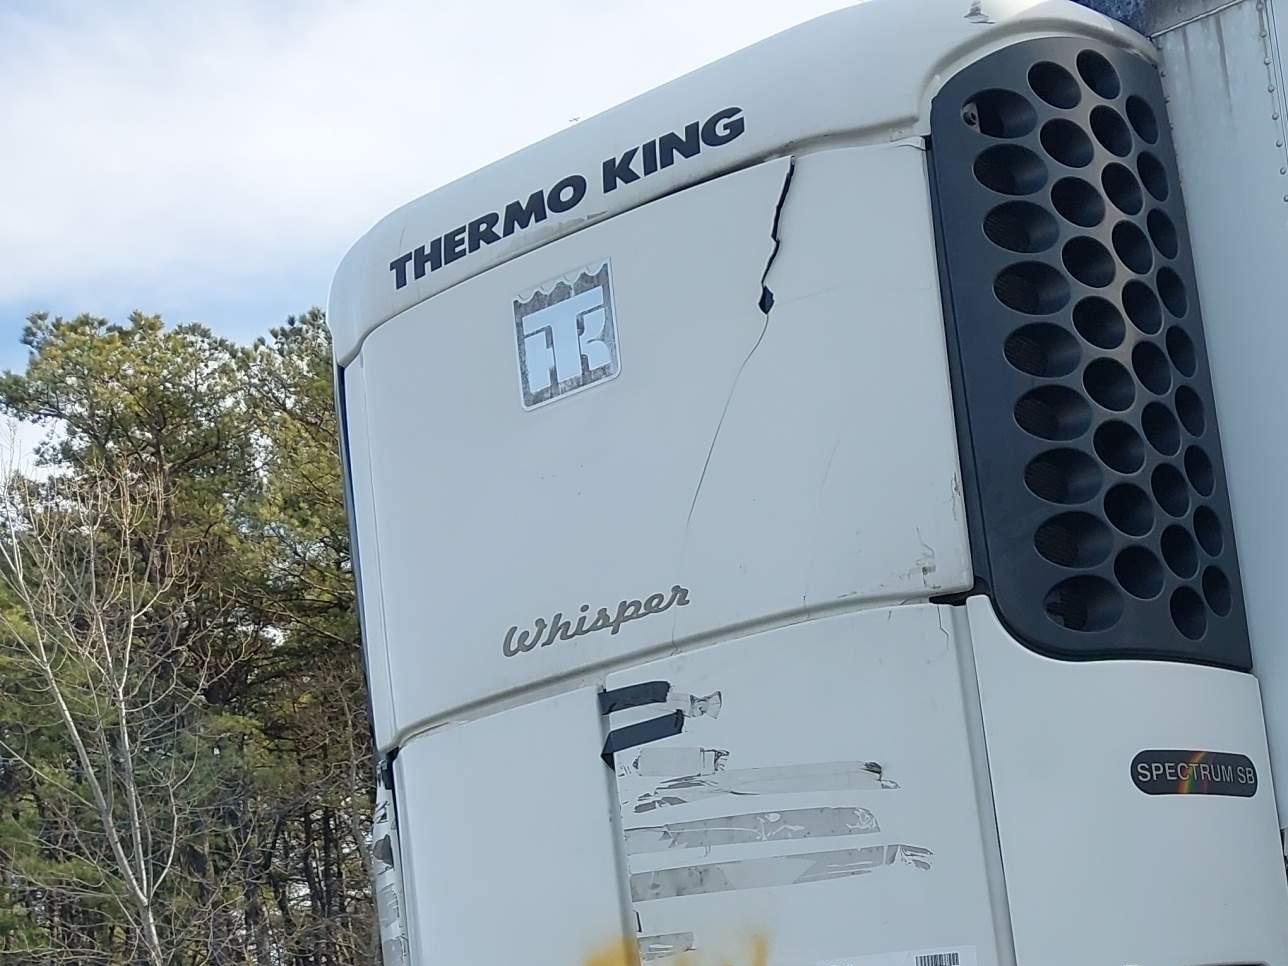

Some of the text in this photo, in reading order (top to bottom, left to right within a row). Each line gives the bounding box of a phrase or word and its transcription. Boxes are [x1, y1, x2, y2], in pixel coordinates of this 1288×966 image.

[389, 106, 745, 290] THERMO KING
[502, 584, 691, 658] Whisper
[1136, 762, 1256, 784] SPECTRUM SB
